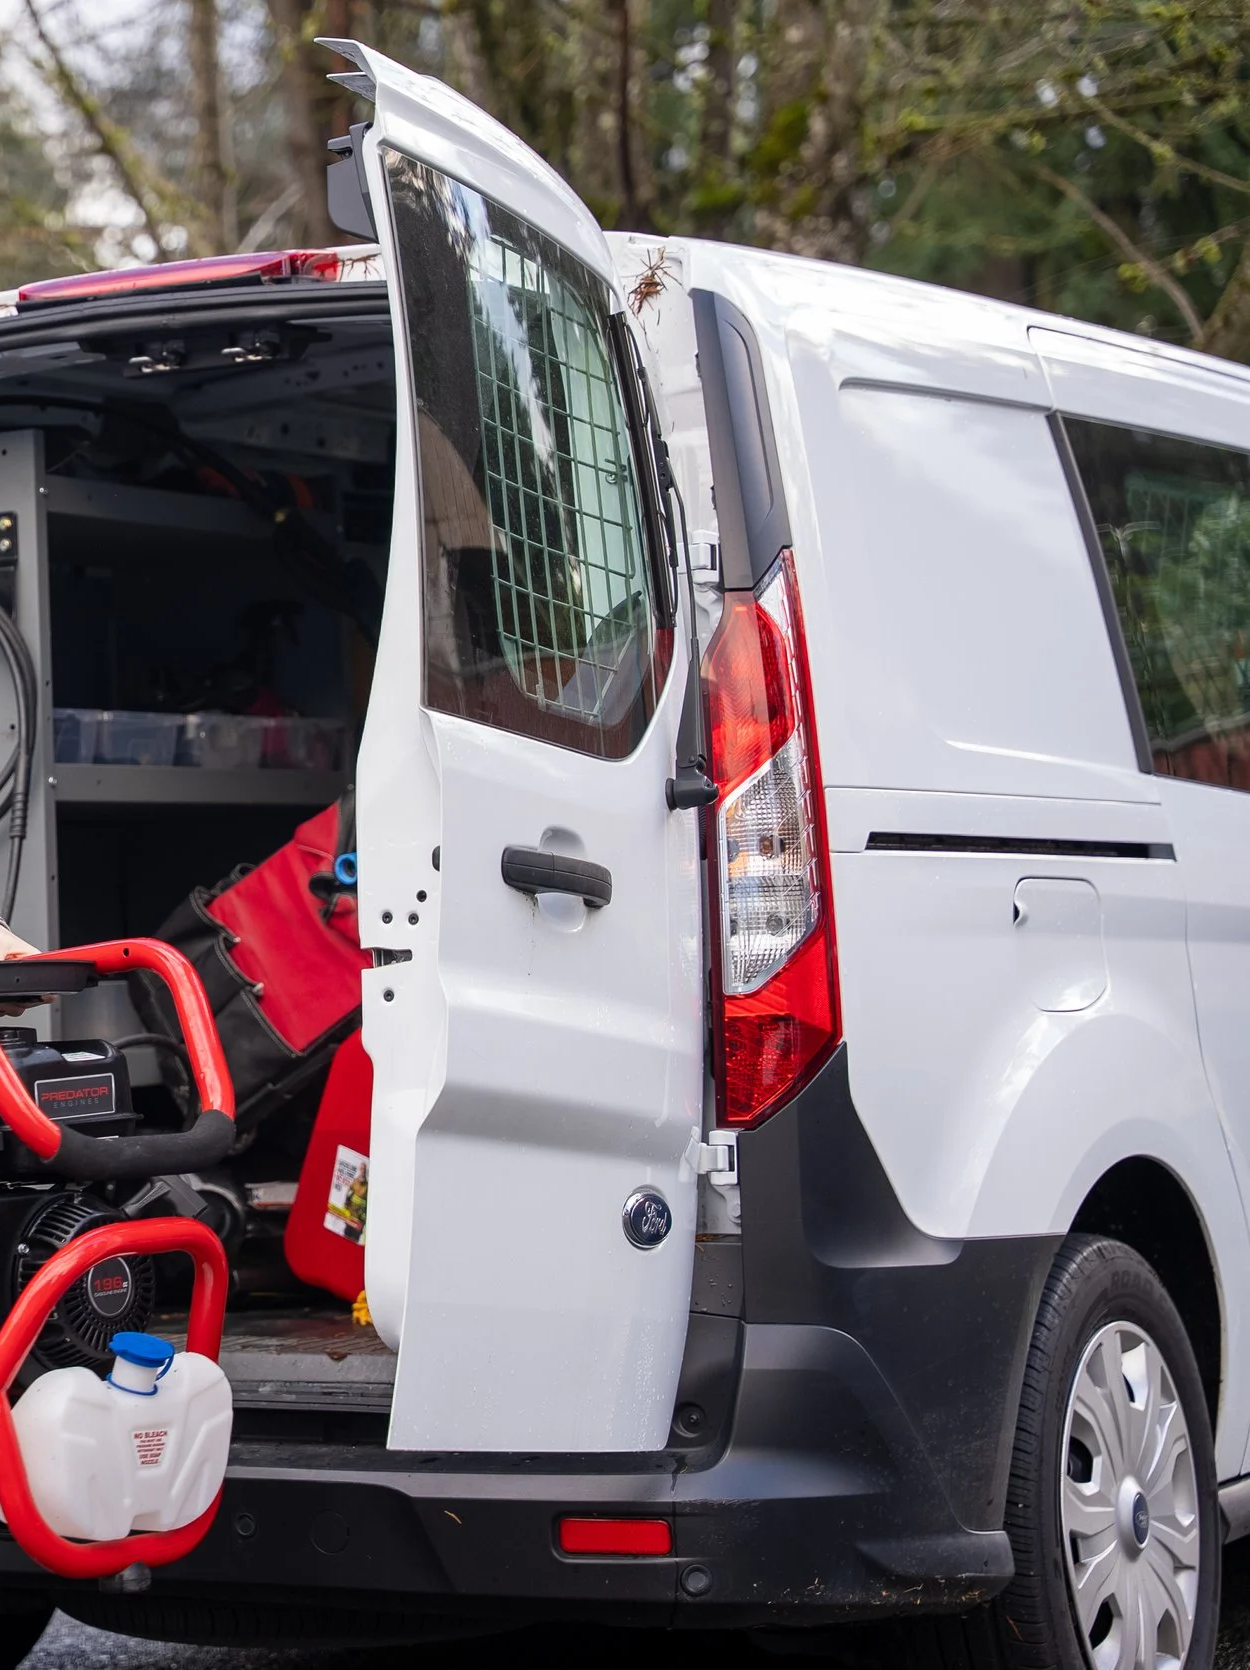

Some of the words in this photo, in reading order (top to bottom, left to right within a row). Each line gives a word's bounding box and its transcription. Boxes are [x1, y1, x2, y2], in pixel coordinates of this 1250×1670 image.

[41, 1087, 108, 1101] PREDATOR
[54, 1098, 99, 1108] ENGINES
[642, 1201, 667, 1235] Ford
[1111, 1270, 1153, 1294] ROAD
